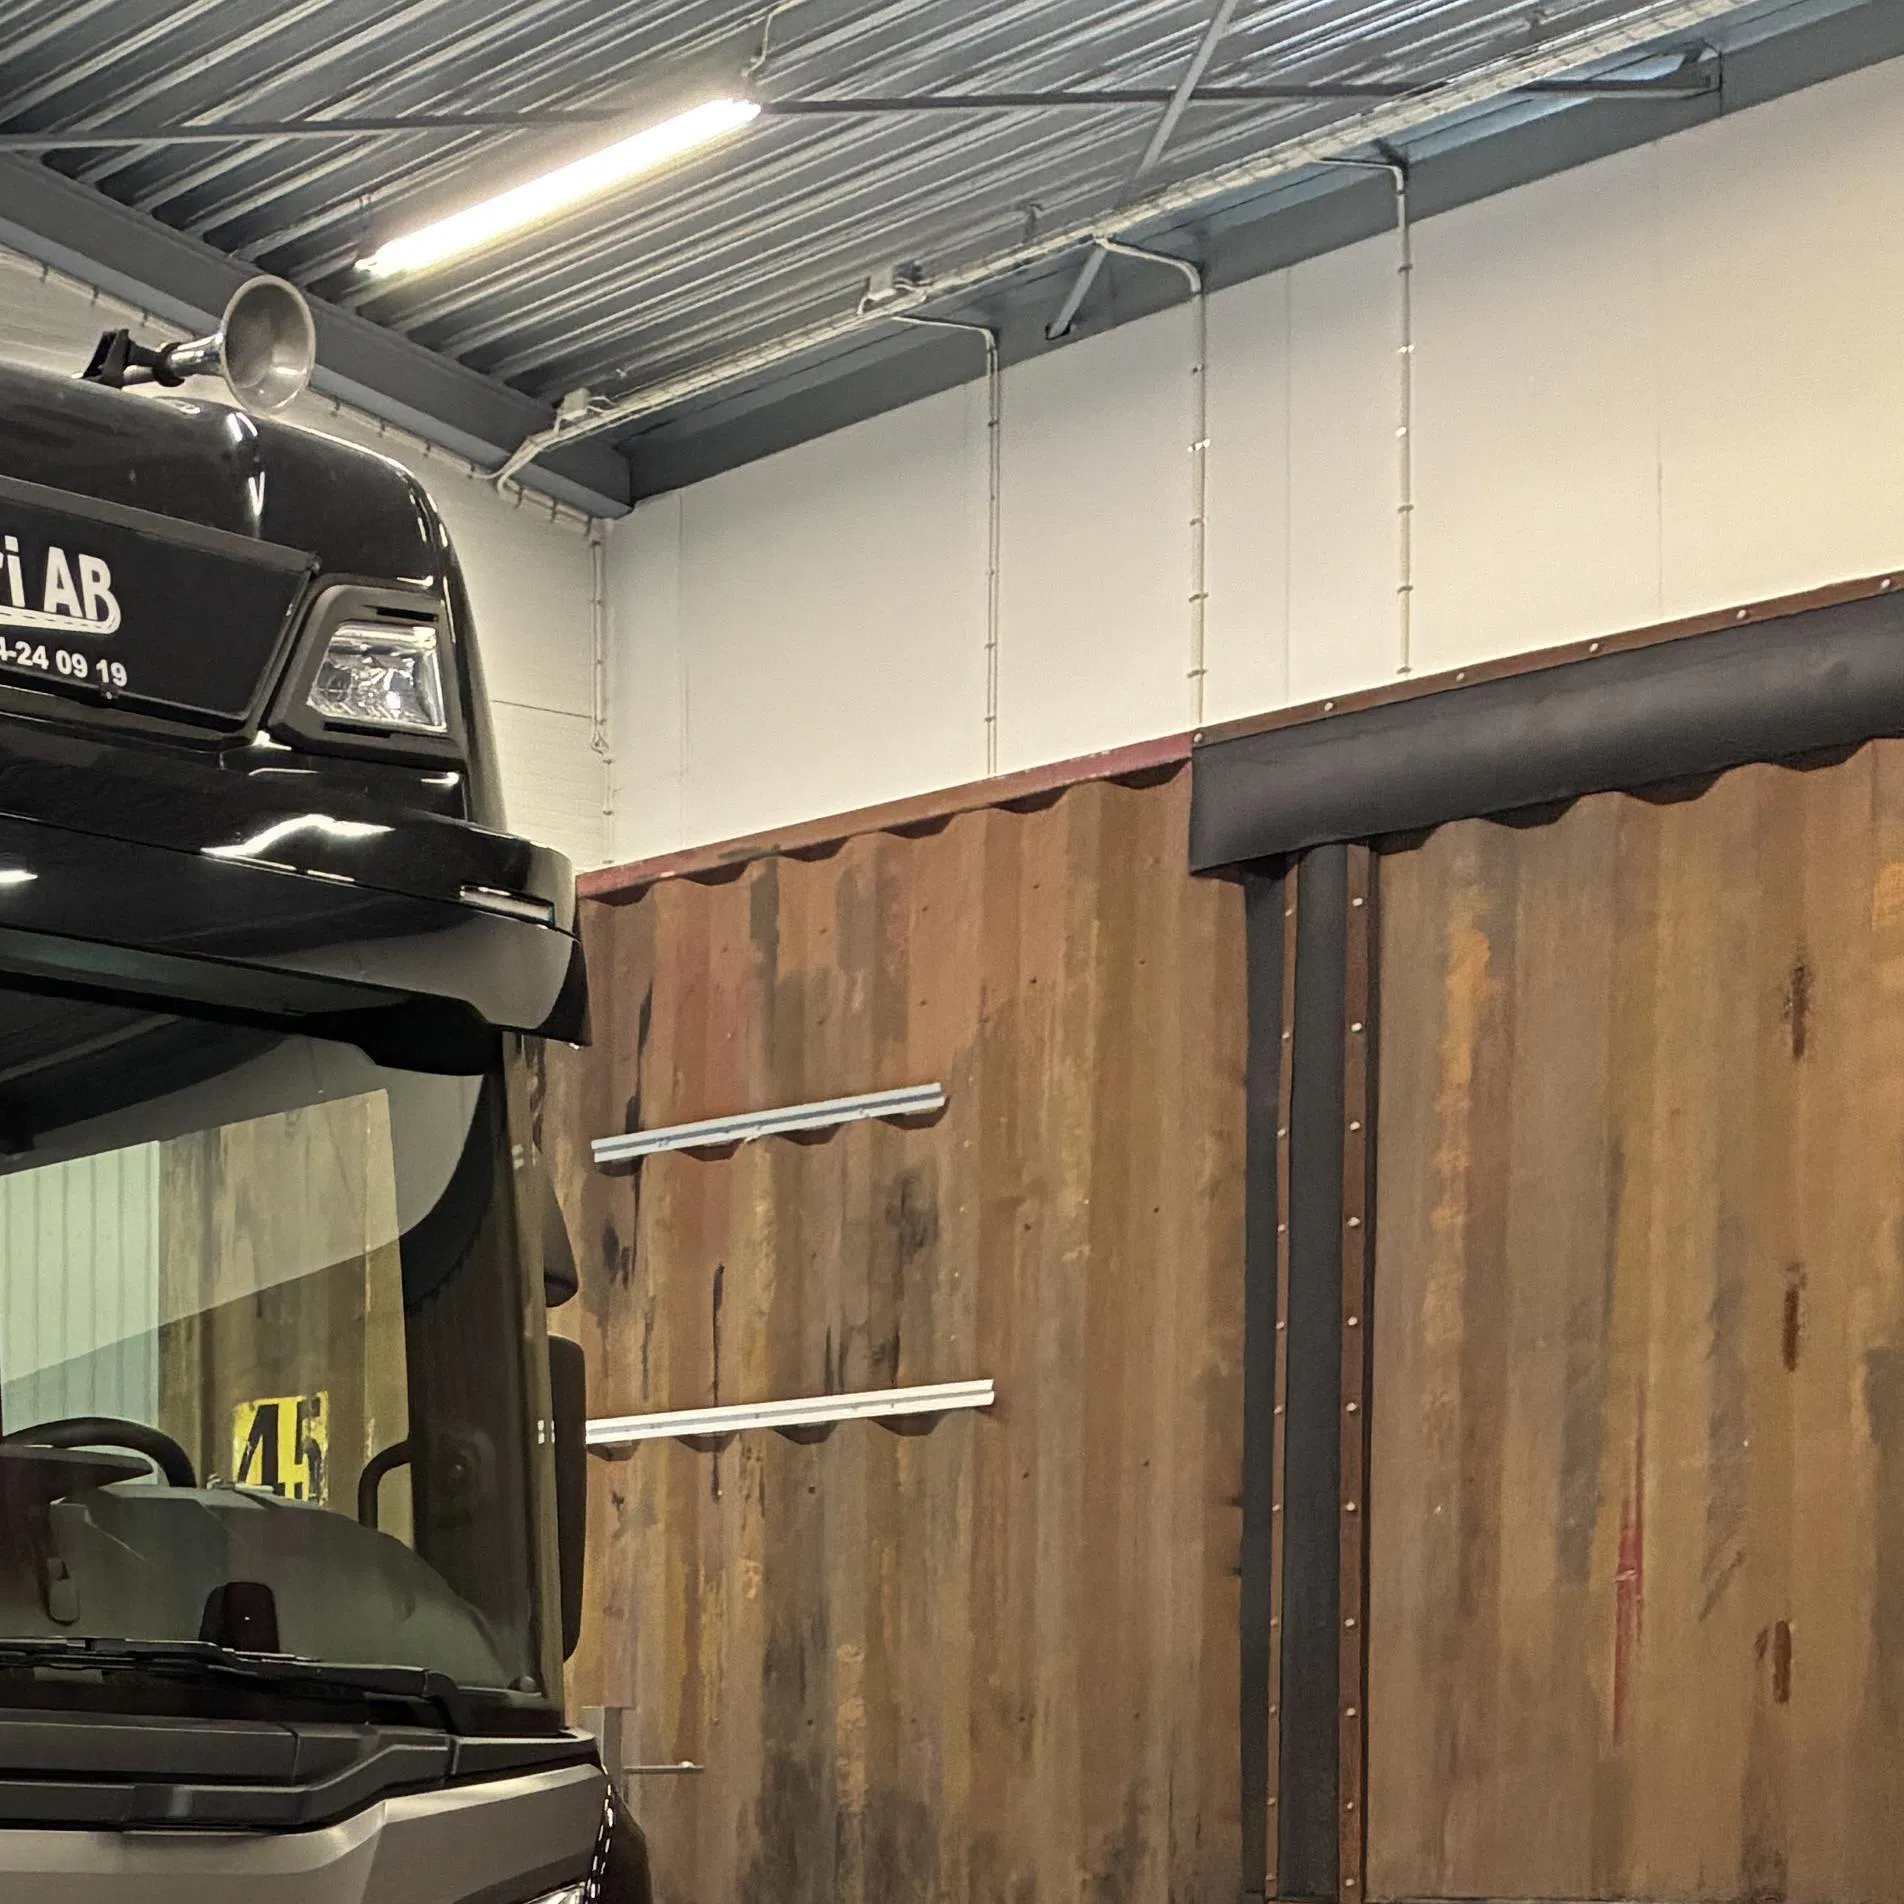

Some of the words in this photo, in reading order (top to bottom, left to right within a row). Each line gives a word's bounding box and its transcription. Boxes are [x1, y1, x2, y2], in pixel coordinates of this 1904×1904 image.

[43, 545, 122, 629] AB
[55, 649, 89, 679] 09
[95, 658, 128, 687] 19
